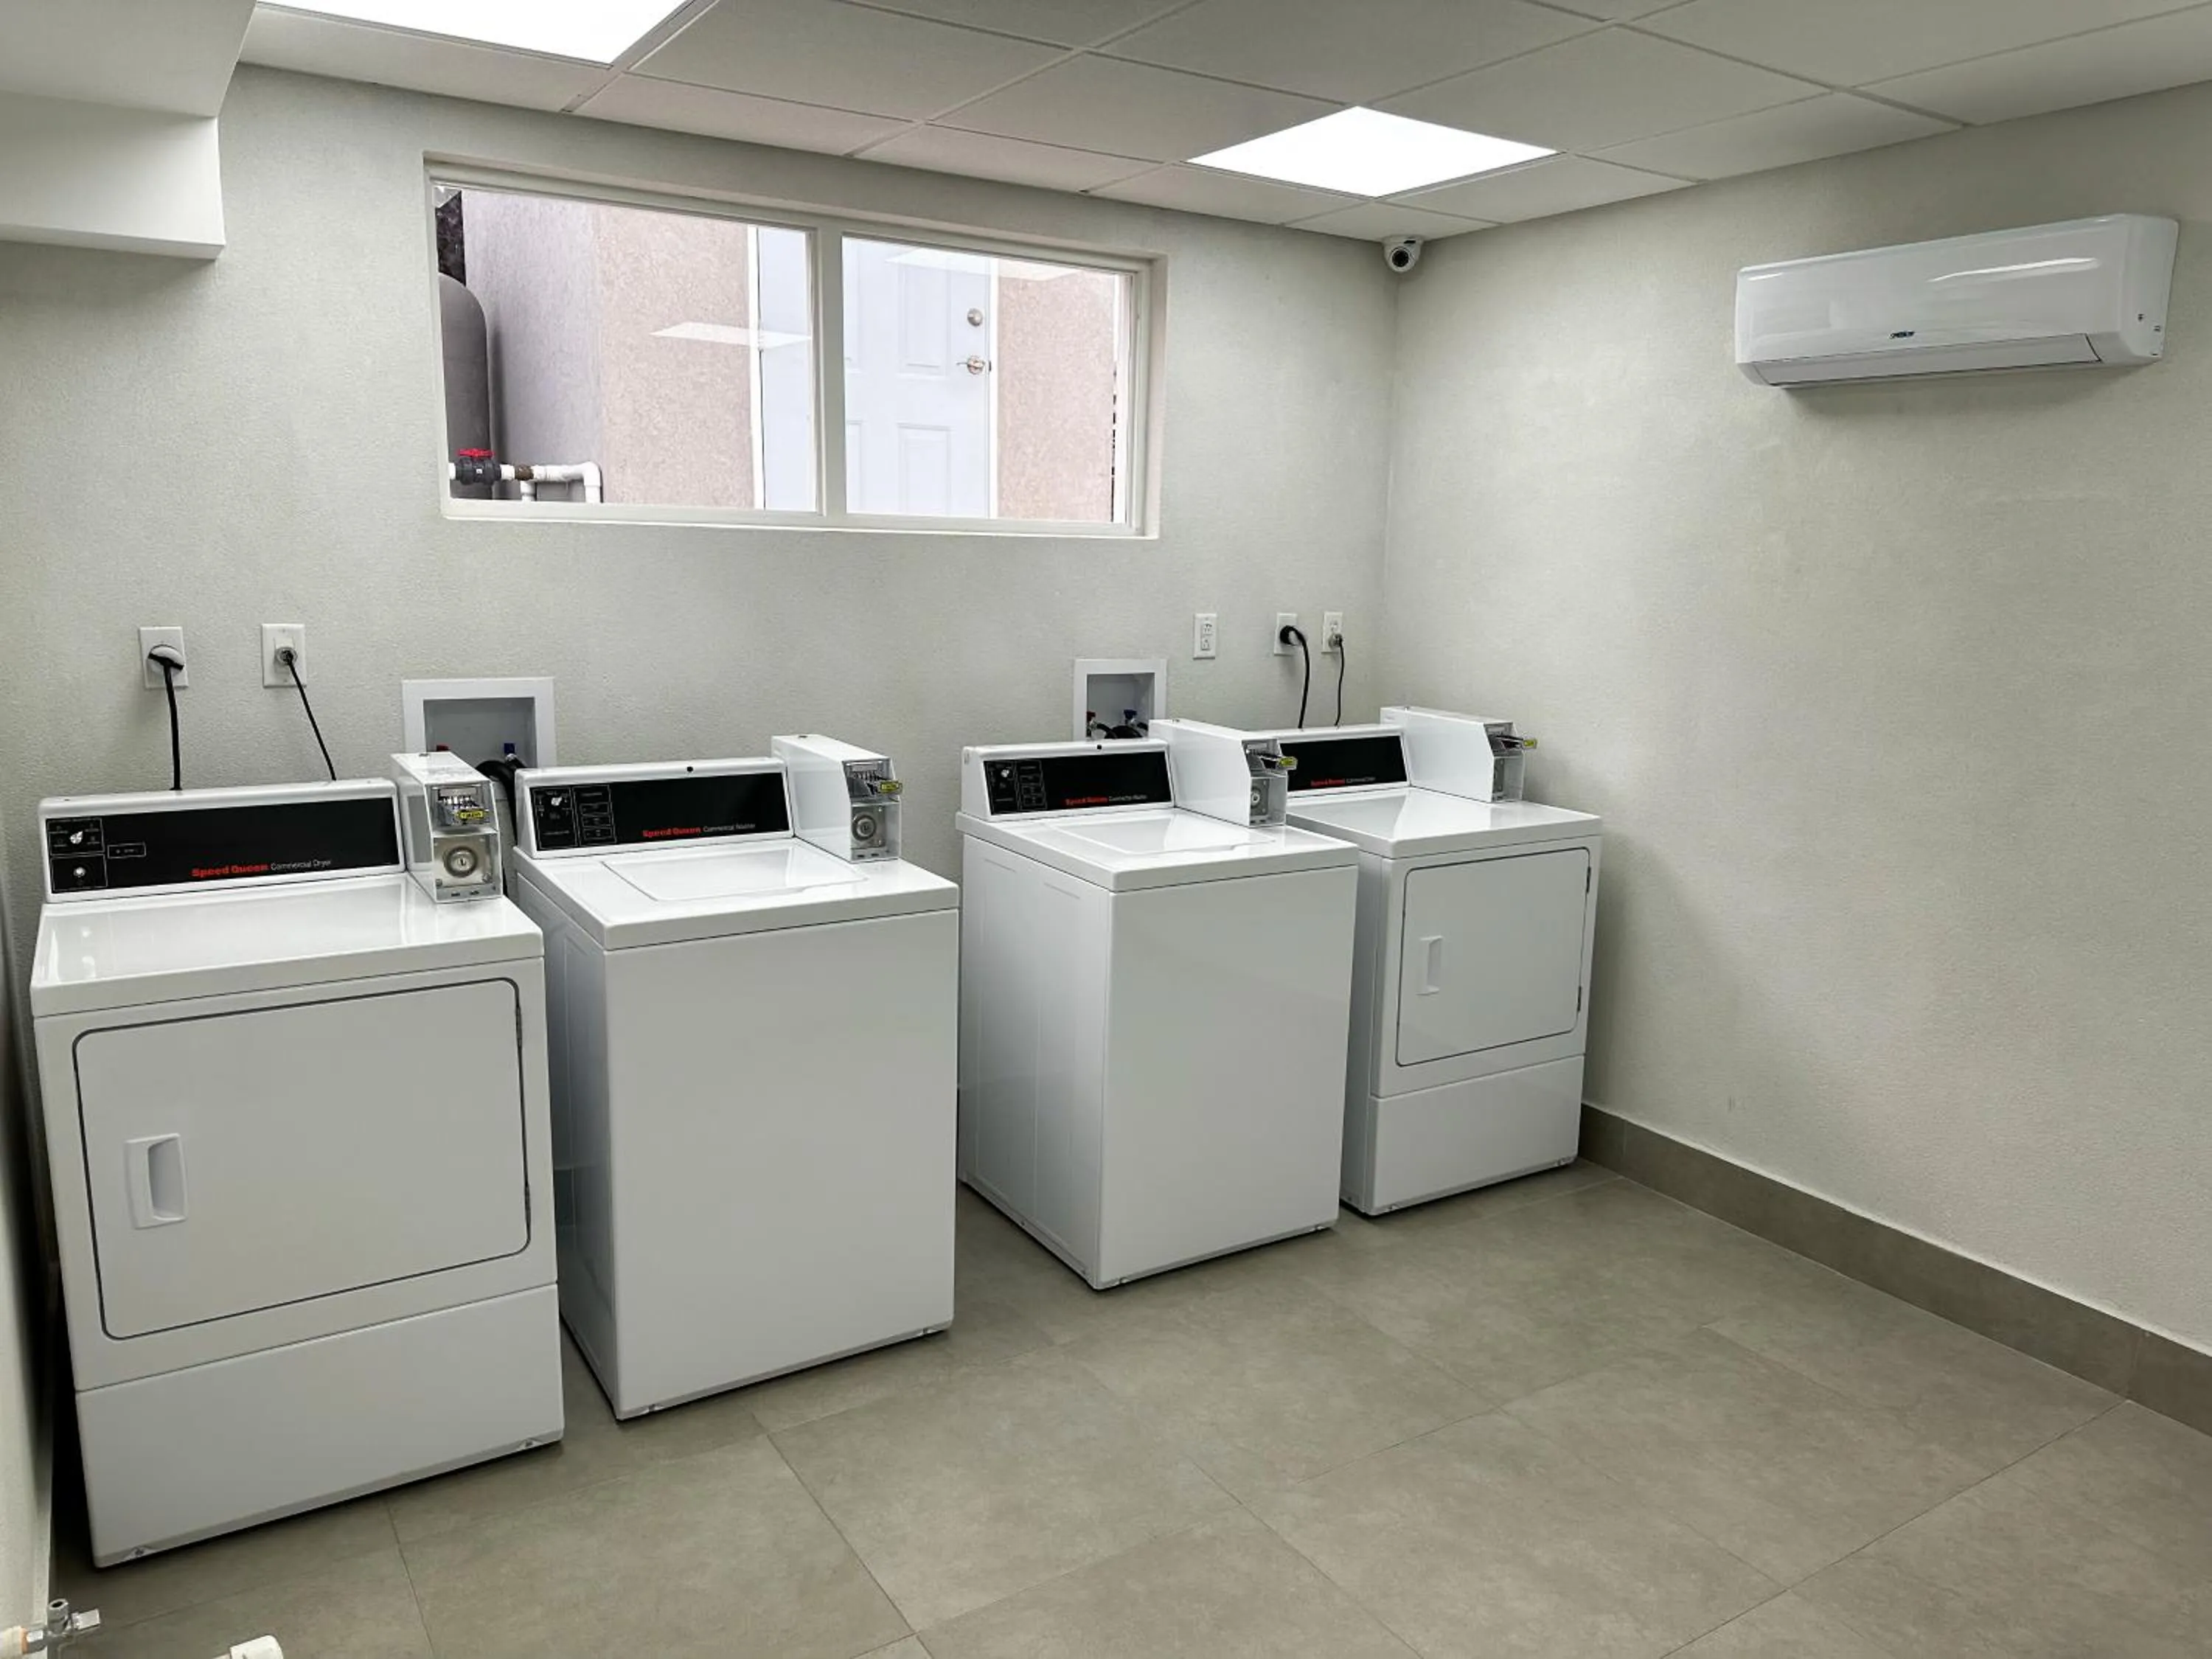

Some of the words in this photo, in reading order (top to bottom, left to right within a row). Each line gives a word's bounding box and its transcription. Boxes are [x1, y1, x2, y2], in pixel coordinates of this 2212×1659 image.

[191, 866, 229, 877] Speed
[231, 863, 269, 874] Queen
[271, 860, 312, 871] Commercial
[313, 859, 332, 868] Dryer
